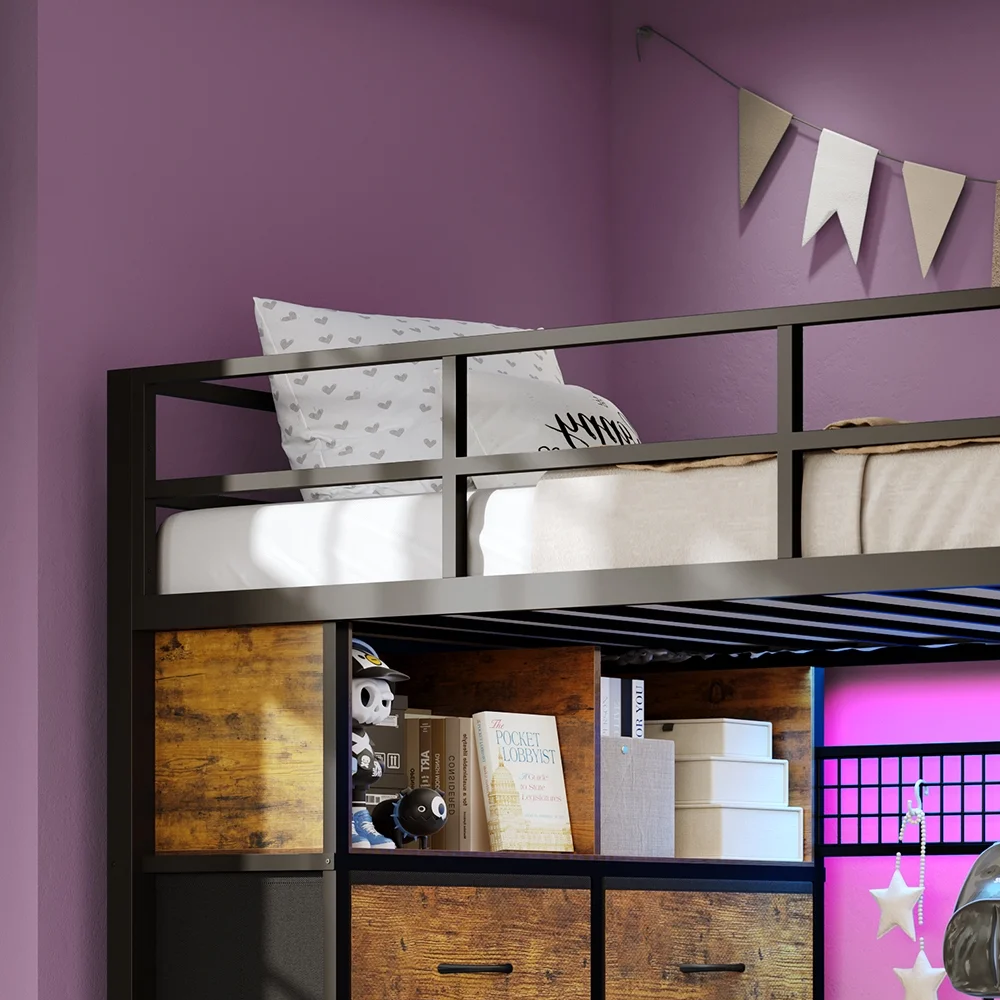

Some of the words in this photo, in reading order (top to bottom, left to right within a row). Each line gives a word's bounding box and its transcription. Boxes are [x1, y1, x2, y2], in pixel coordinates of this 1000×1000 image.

[489, 719, 504, 729] The
[495, 730, 540, 747] POCKET
[502, 746, 556, 764] LOBBYIST
